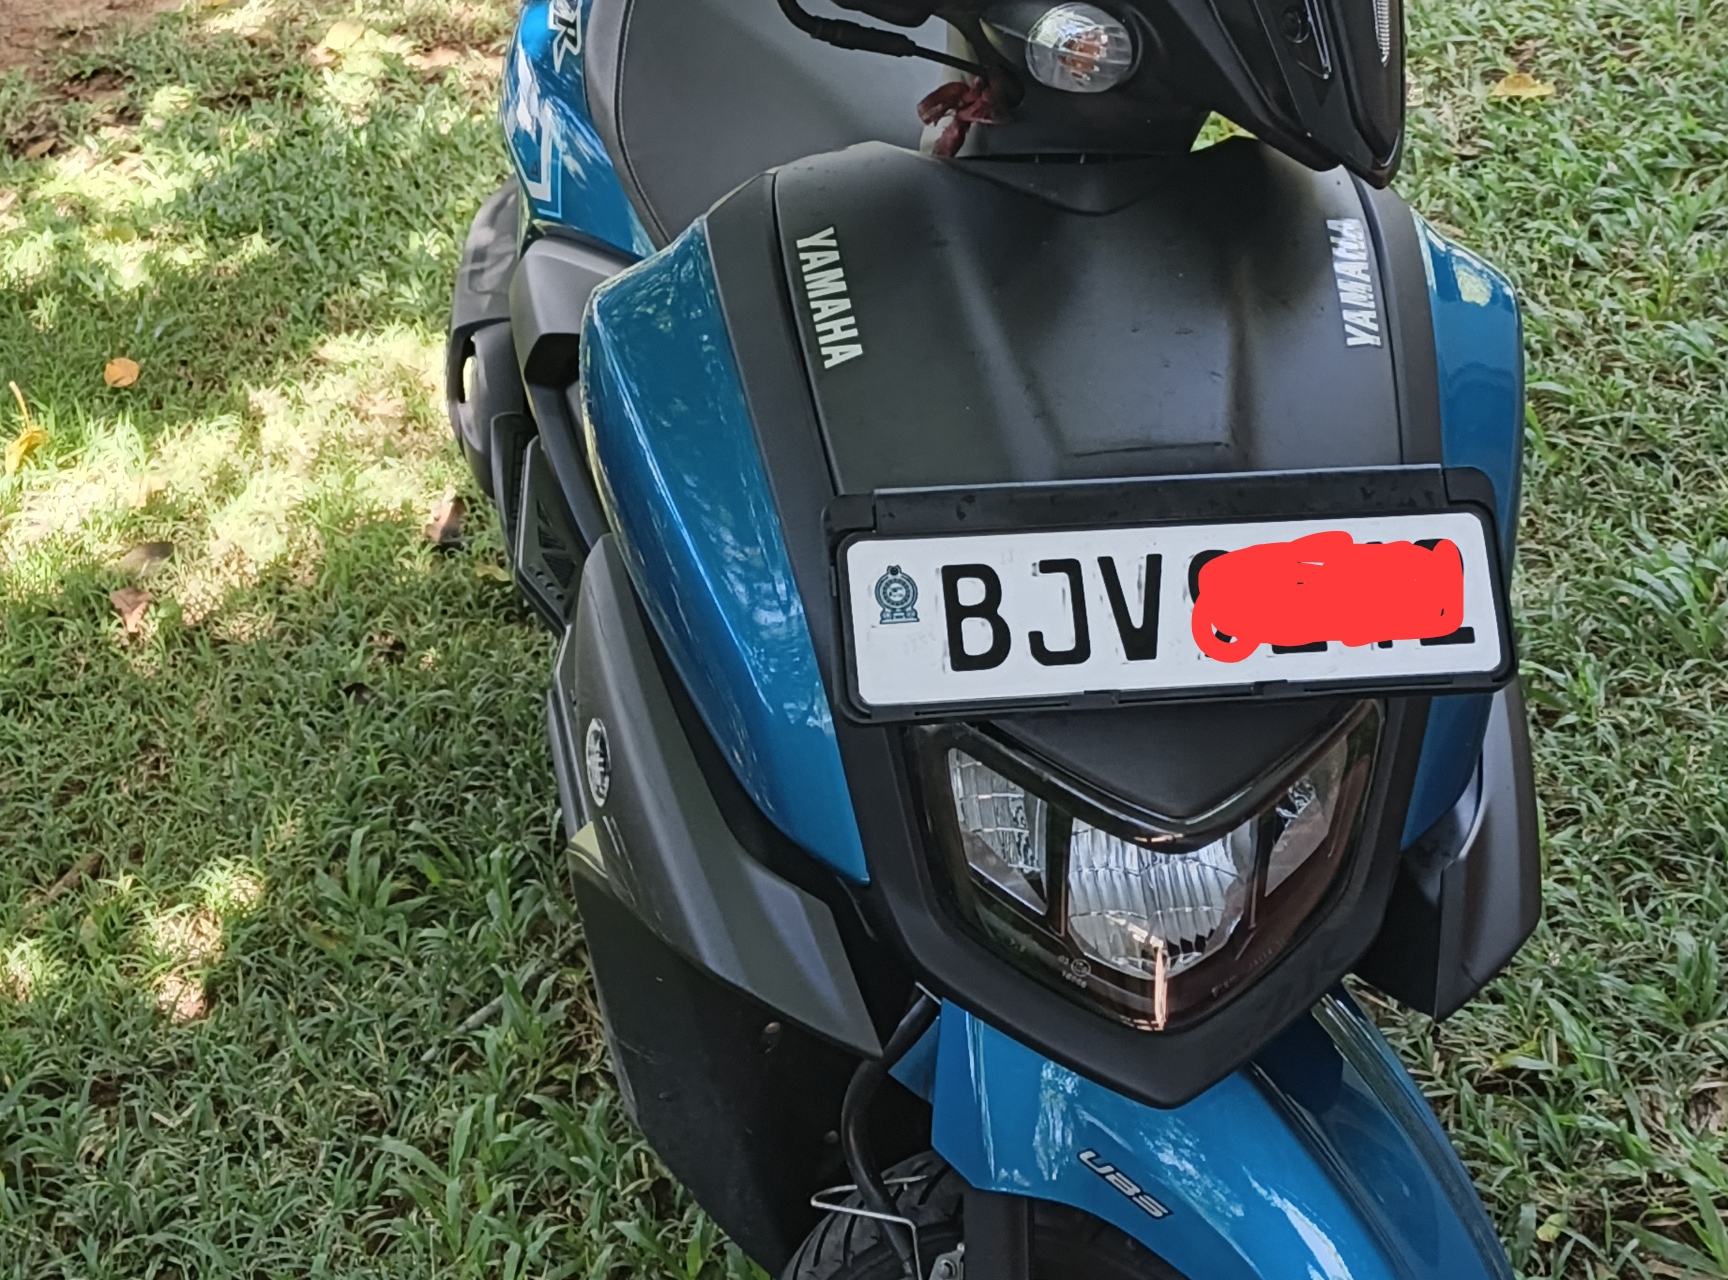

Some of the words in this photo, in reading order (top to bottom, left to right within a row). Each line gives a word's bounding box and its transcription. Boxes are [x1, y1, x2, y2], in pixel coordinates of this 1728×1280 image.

[796, 226, 863, 369] YAMAHA
[1326, 218, 1382, 347] YAMAHA
[941, 553, 1162, 672] BJV
[1078, 1149, 1171, 1219] UBS
